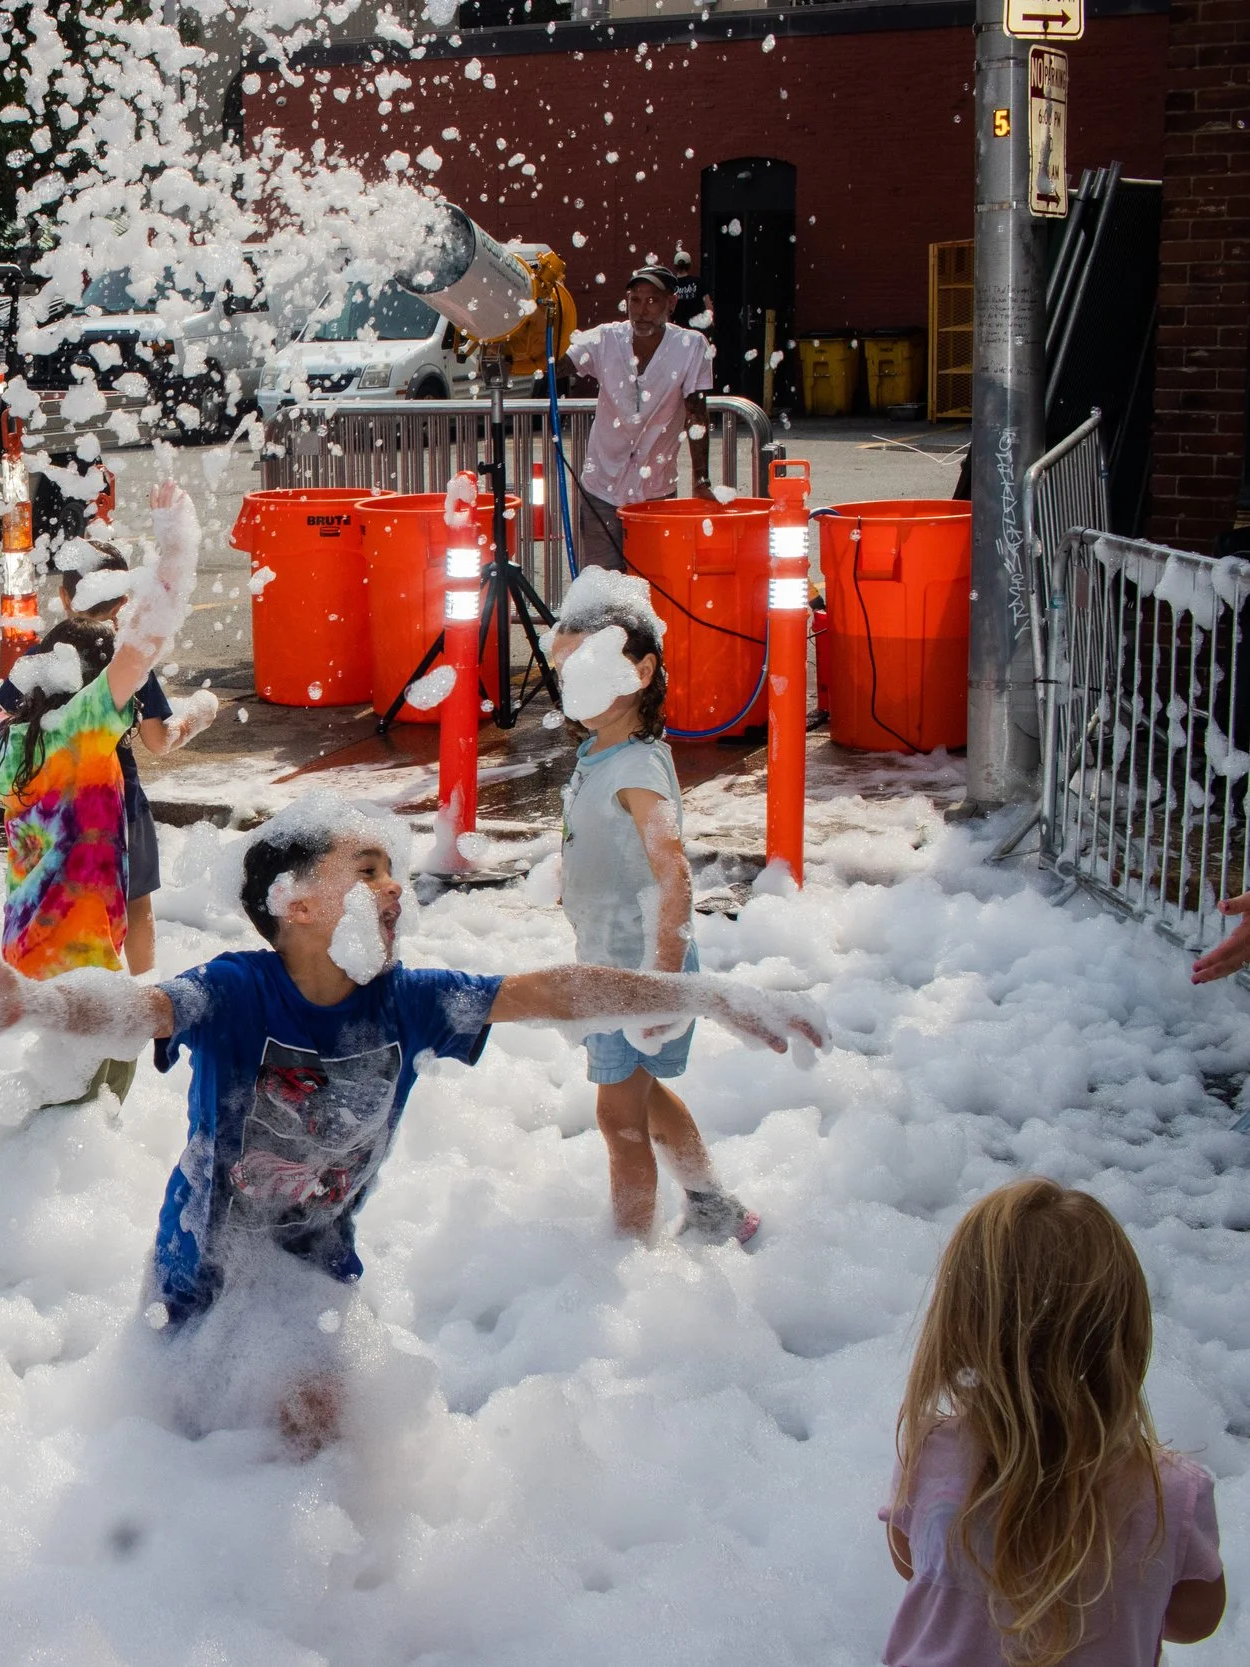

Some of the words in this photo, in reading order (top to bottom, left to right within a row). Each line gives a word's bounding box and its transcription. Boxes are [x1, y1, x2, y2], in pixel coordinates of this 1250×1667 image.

[1031, 57, 1044, 89] NO
[995, 110, 1009, 136] 5
[307, 515, 351, 526] BRUTE
